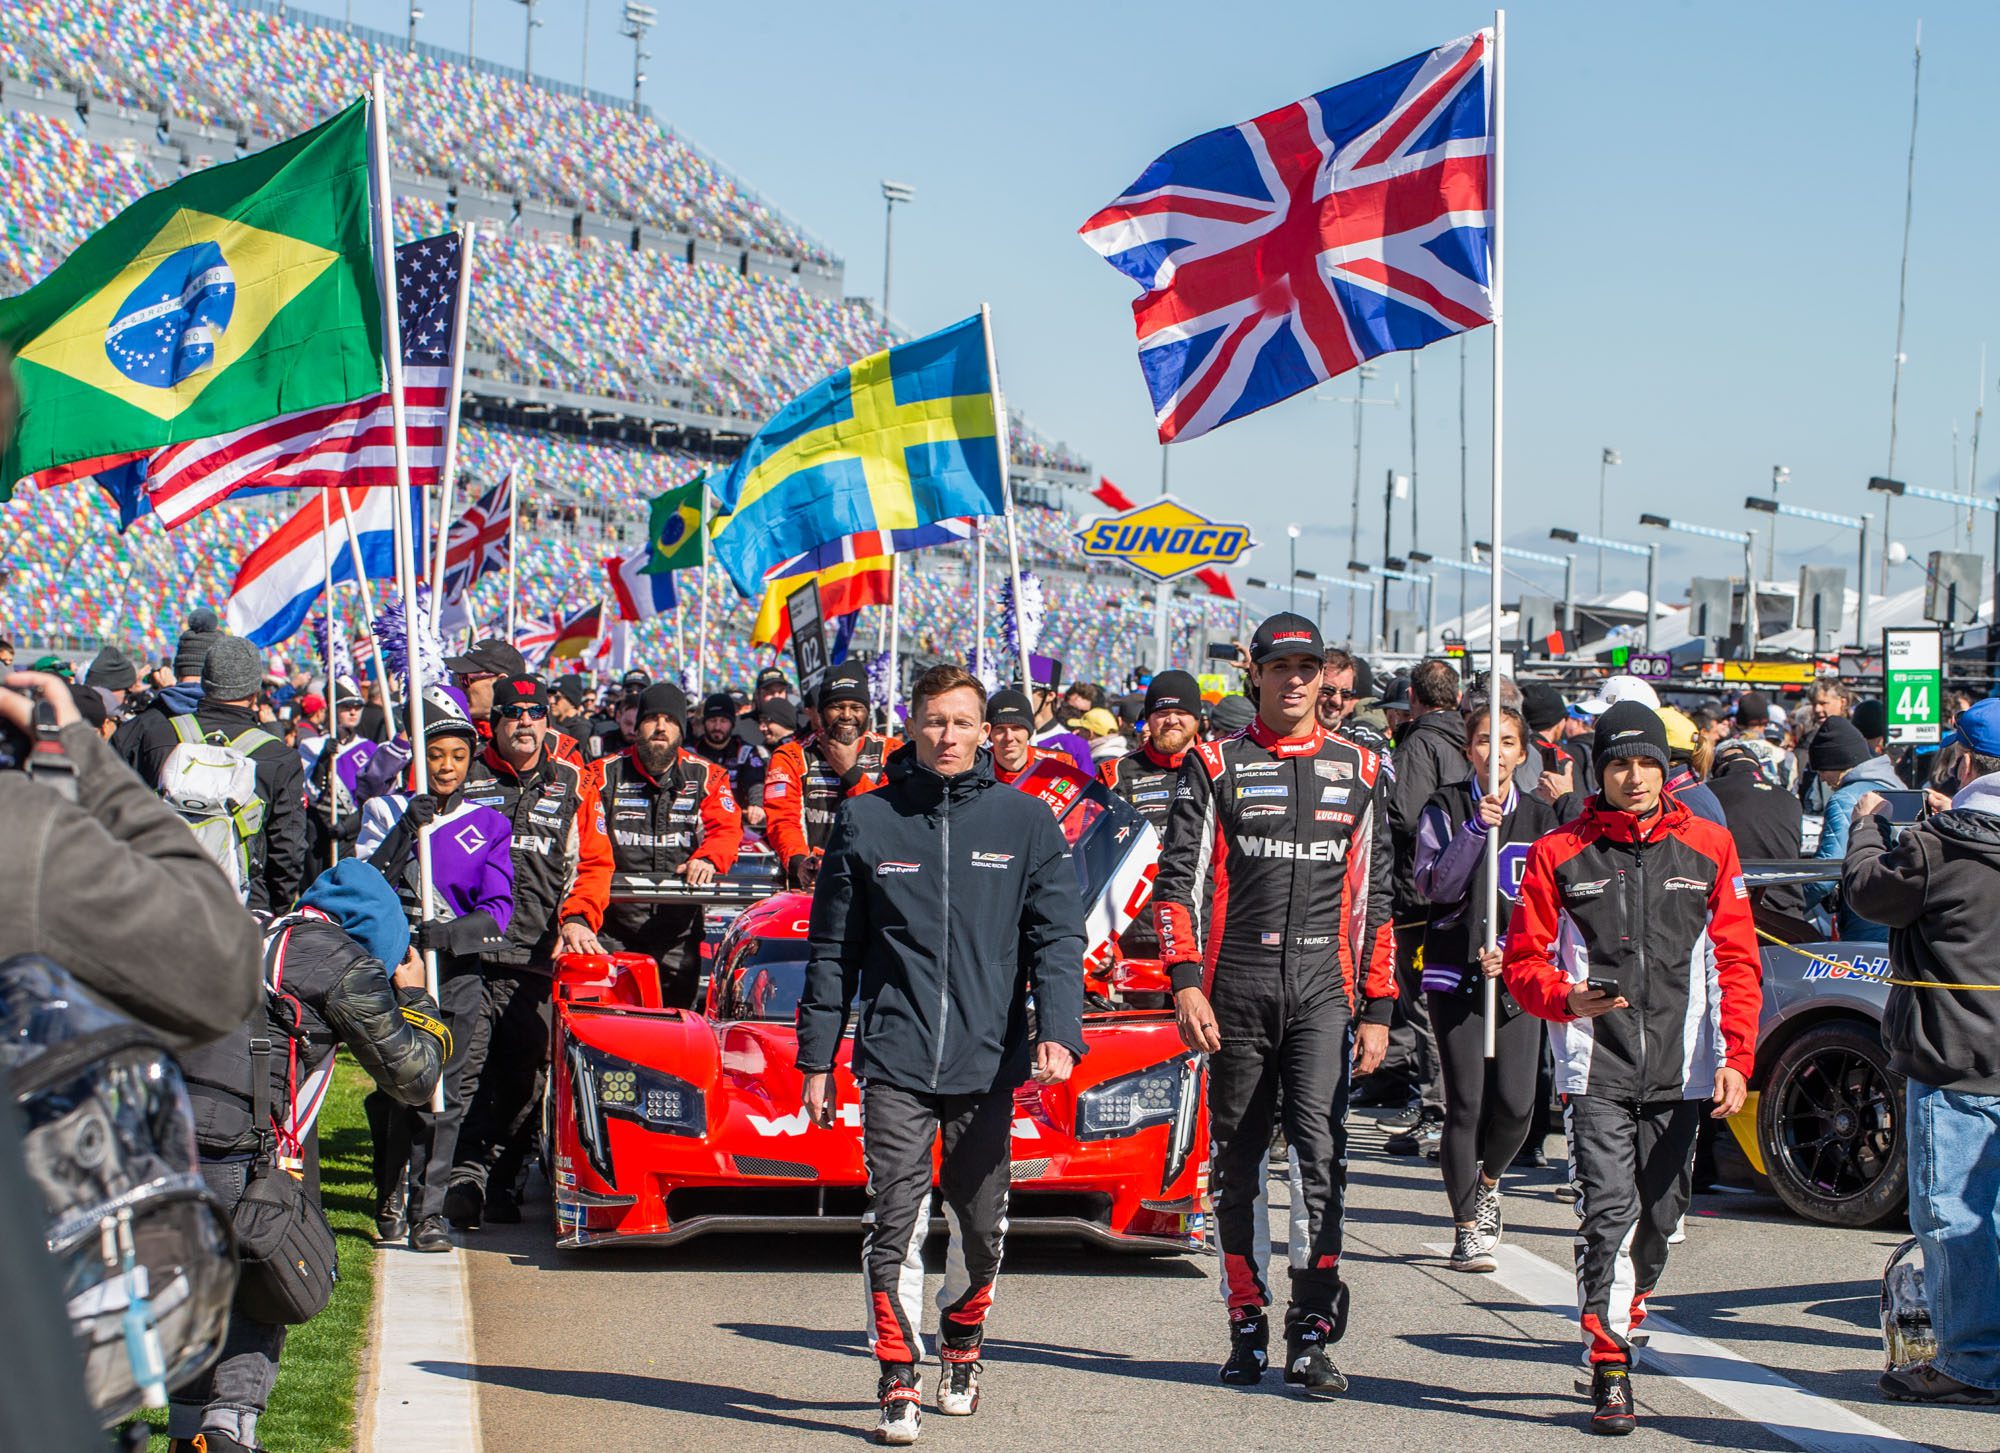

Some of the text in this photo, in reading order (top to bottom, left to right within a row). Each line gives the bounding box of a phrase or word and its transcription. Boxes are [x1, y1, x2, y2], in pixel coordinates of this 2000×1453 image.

[1090, 524, 1243, 556] SUNOCO
[802, 636, 821, 673] 02
[1630, 658, 1649, 675] 60
[1896, 686, 1930, 721] 44
[1280, 739, 1316, 753] WHELEN
[1316, 811, 1353, 824] LUCAS OIL
[510, 834, 552, 855] LEN
[614, 829, 691, 847] WHELEN
[1236, 835, 1348, 862] WHELEN
[1304, 936, 1330, 945] NUNEZ
[1803, 954, 1890, 983] Mobil
